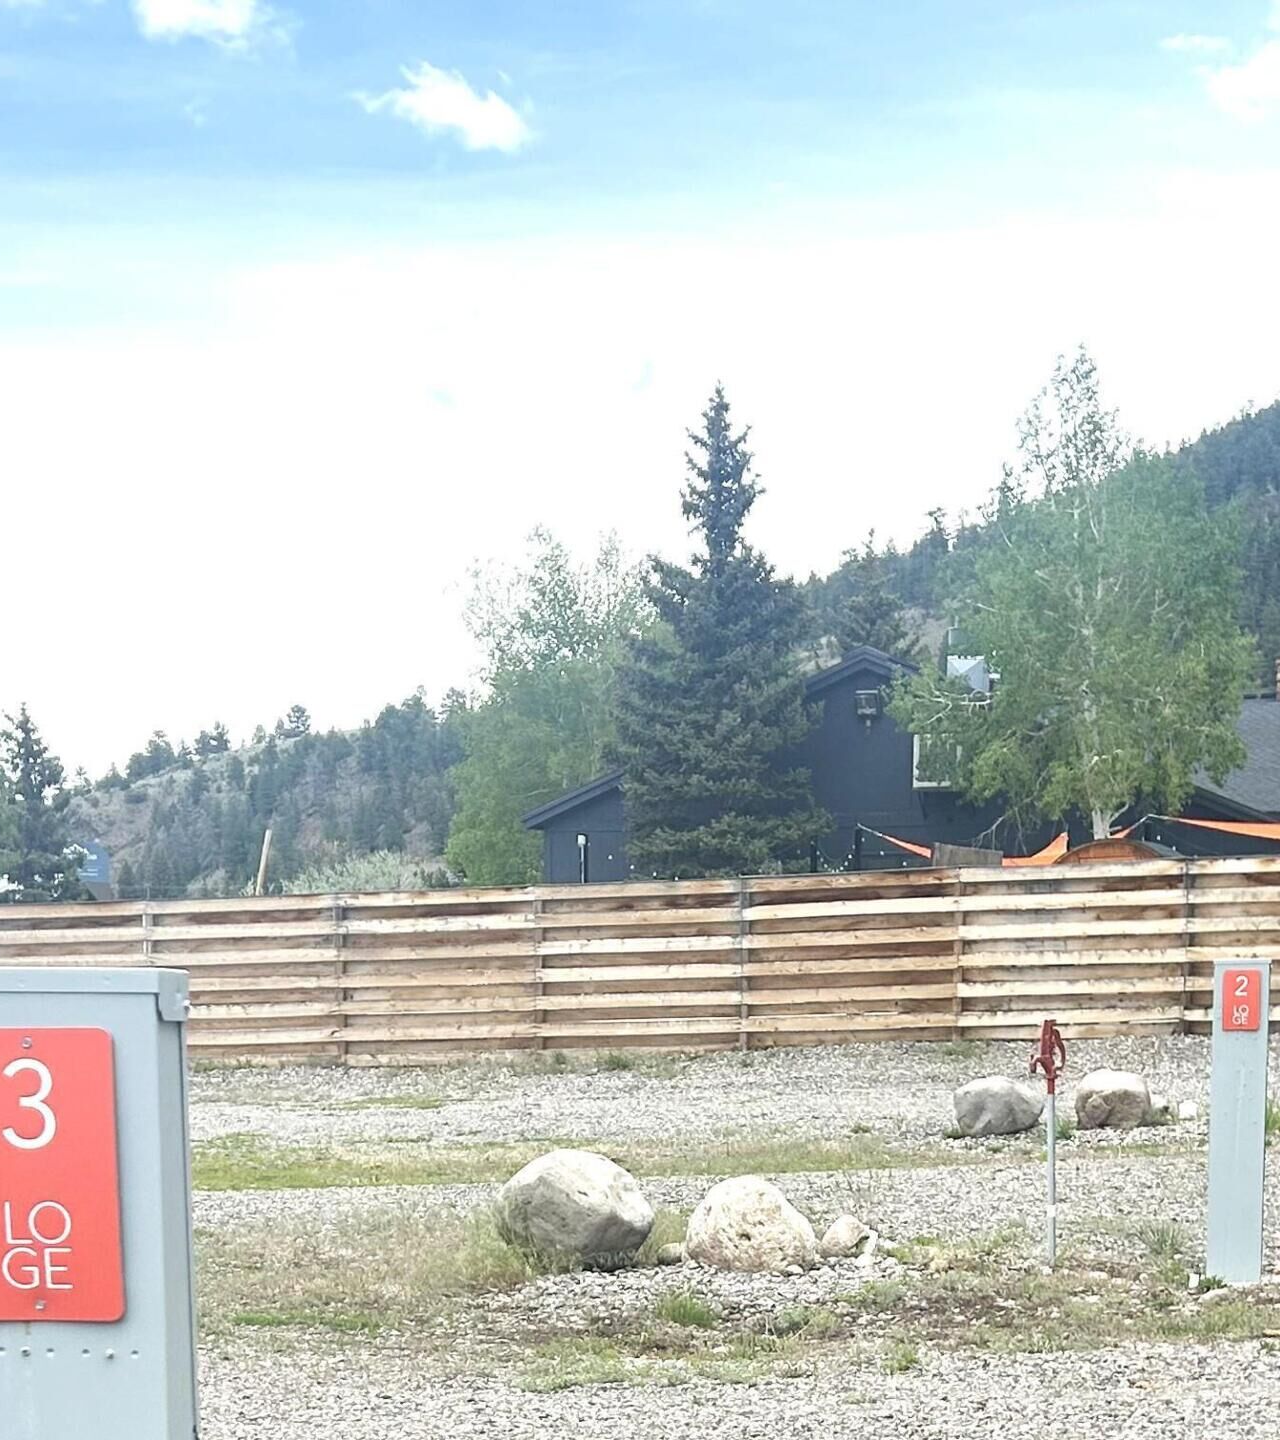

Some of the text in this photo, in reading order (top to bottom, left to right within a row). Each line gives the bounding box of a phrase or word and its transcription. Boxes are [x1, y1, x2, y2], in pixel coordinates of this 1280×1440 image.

[1234, 975, 1249, 997] 2
[1232, 1015, 1249, 1025] GE
[1233, 1004, 1249, 1016] LO
[2, 1057, 57, 1150] 3
[3, 1200, 72, 1245] LO
[1, 1246, 74, 1289] GE
